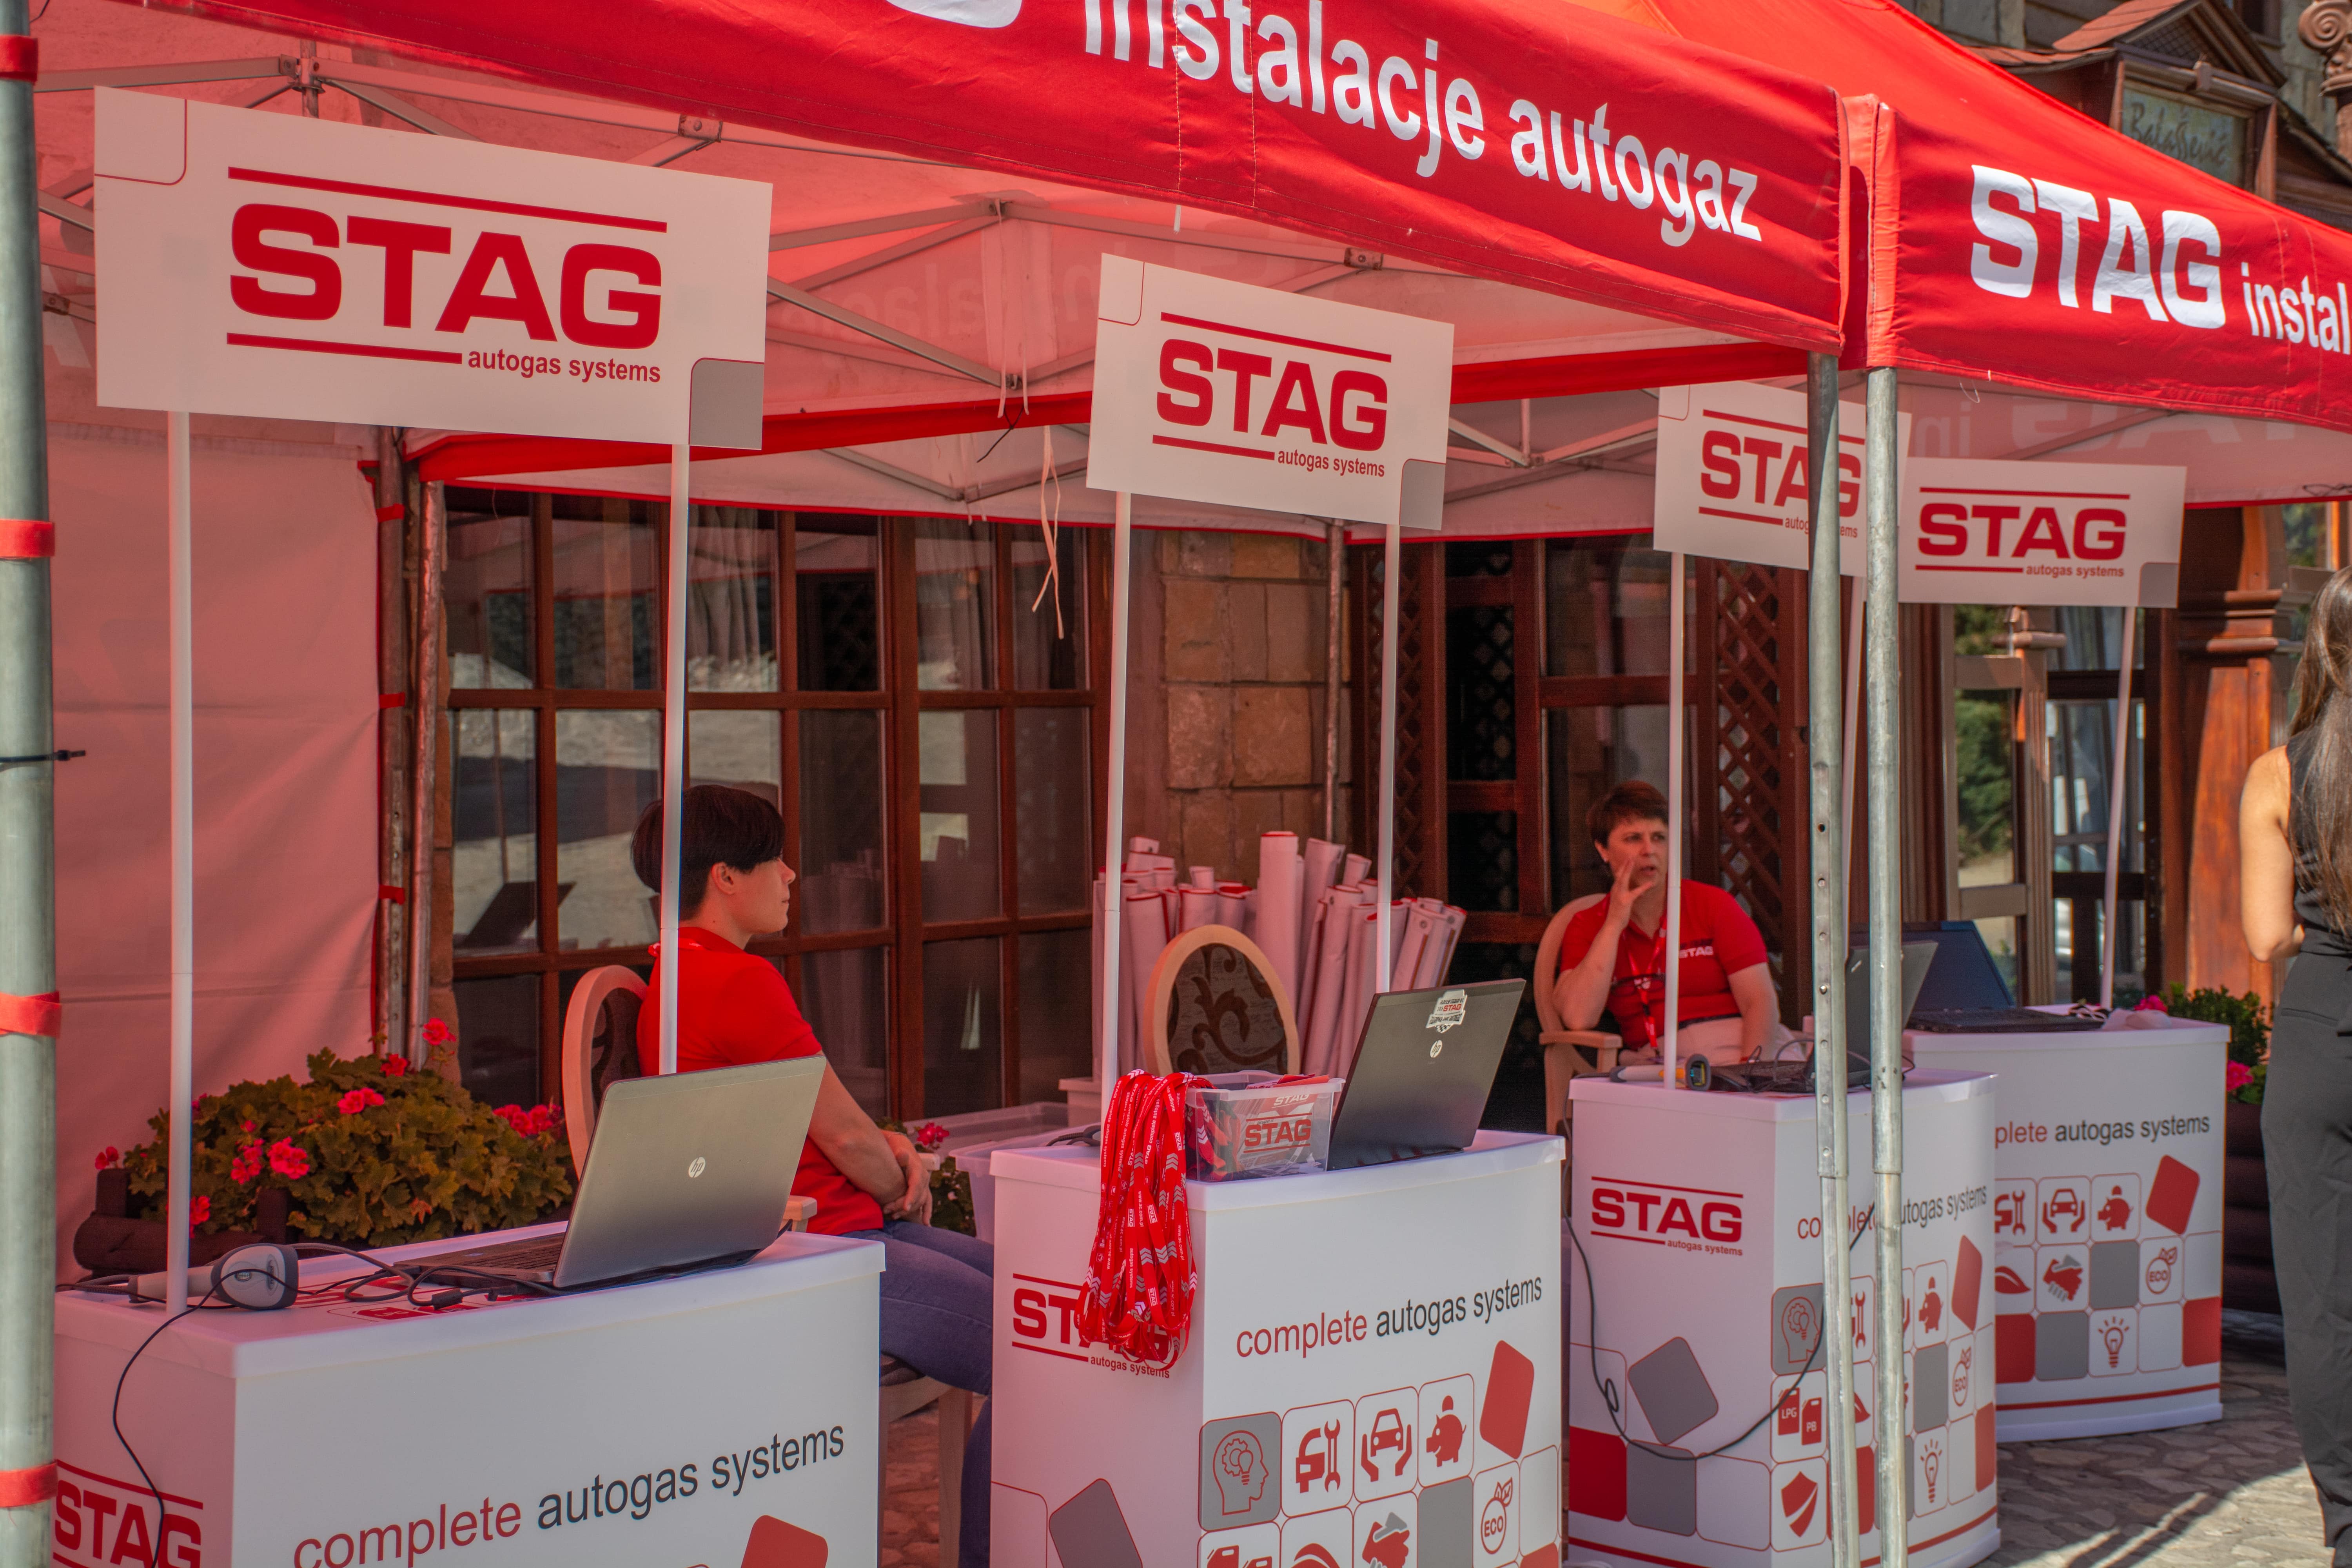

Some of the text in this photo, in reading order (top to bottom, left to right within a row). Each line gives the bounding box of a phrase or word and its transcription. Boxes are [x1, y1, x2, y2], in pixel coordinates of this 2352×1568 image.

[1510, 99, 1761, 247] autogaz
[230, 203, 662, 349] STAG
[1971, 164, 2350, 355] STAG instal
[468, 347, 661, 383] autogas systems
[1157, 338, 1389, 450] STAG
[1277, 448, 1385, 479] autogas systems
[1700, 431, 1861, 517] STAG
[1785, 517, 1809, 534] autog
[1919, 503, 2125, 560] STAG
[2025, 563, 2124, 579] autogas systems
[1431, 1040, 1442, 1058] hp
[1245, 1119, 1311, 1147] STAG
[2055, 1120, 2134, 1145] autogas
[2140, 1115, 2210, 1143] systems
[689, 1157, 706, 1178] hp
[1592, 1188, 1743, 1243] STAG
[1947, 1185, 1987, 1221] systems
[1667, 1238, 1743, 1256] autogas systems
[1236, 1276, 1542, 1358] complete autogas systems
[1091, 1355, 1127, 1371] autogas
[1781, 1407, 1817, 1432] LPG PB
[294, 1425, 844, 1568] complete autogas systems
[55, 1479, 201, 1568] STAG
[1484, 1518, 1504, 1538] ECO
